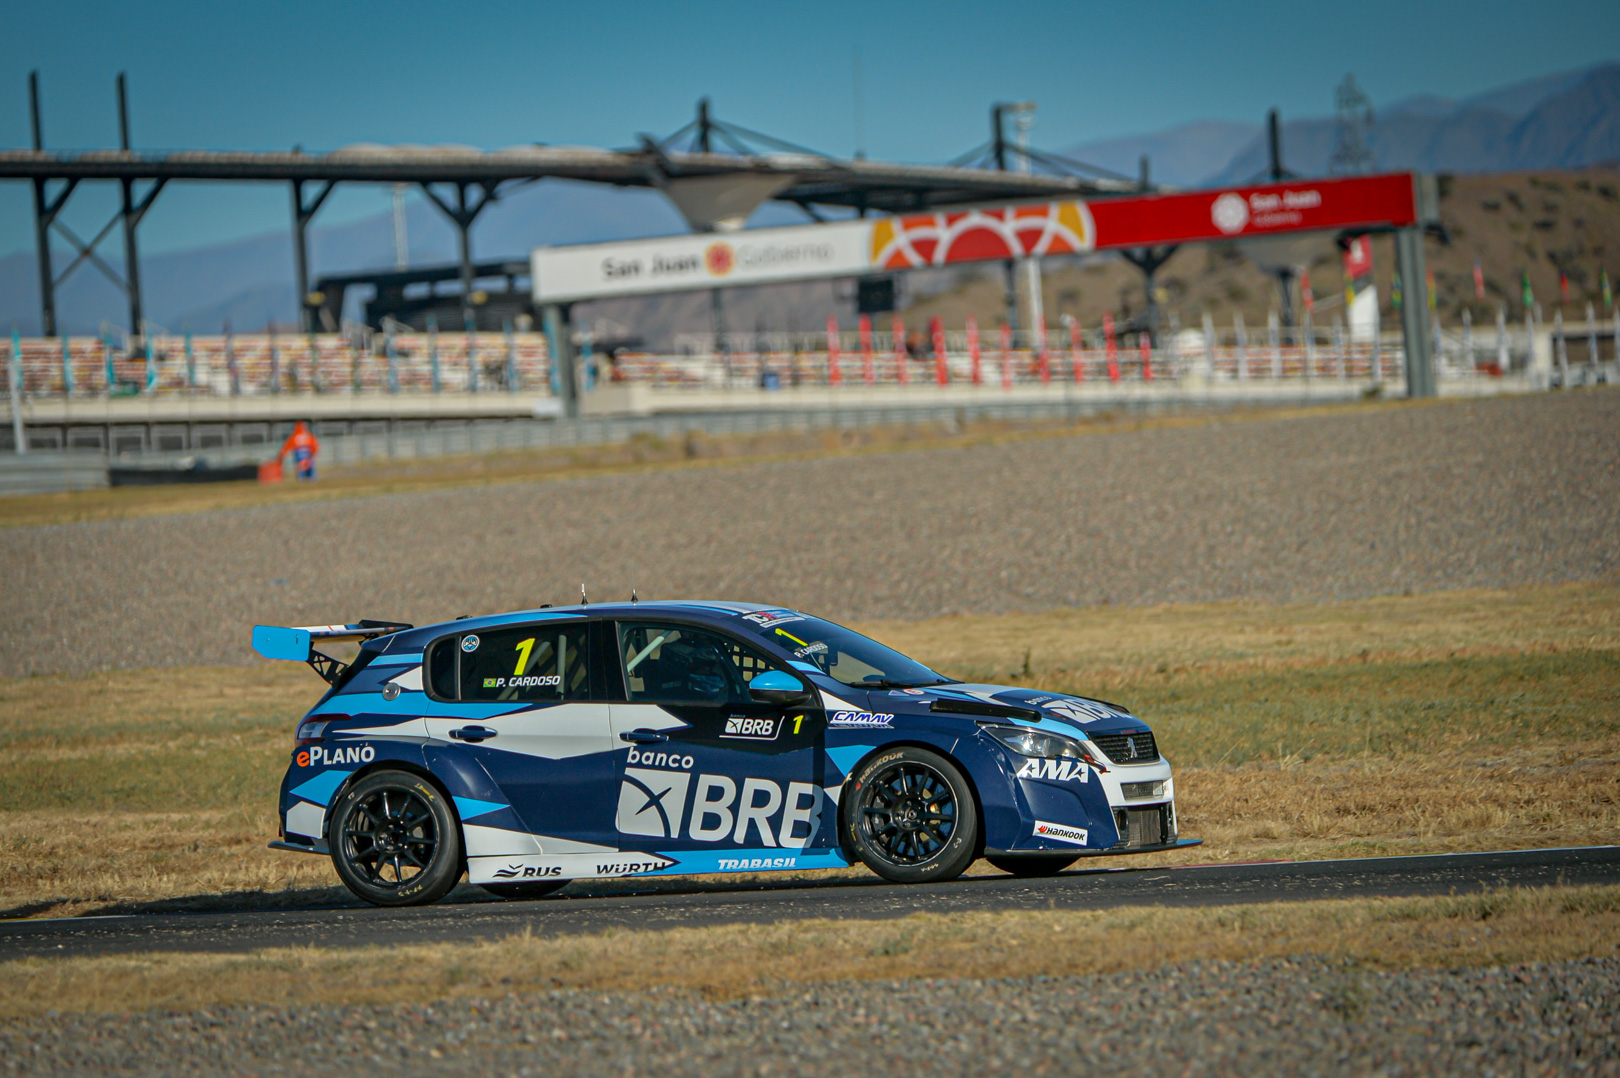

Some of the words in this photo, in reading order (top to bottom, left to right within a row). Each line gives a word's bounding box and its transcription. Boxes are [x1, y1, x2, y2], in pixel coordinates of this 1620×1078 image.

[602, 258, 642, 278] San
[652, 254, 700, 277] Juan
[775, 628, 808, 647] 1
[513, 638, 535, 676] 1
[496, 678, 506, 687] P.
[508, 675, 561, 687] CARDOSO
[793, 715, 804, 734] 1
[832, 711, 895, 724] CAMAV
[741, 719, 774, 736] BRB
[626, 746, 694, 769] banco
[1017, 758, 1089, 783] AMA
[689, 773, 824, 849] BRB
[522, 866, 562, 878] RUS
[596, 861, 666, 875] WÜRTH
[718, 857, 797, 870] TRABASIL
